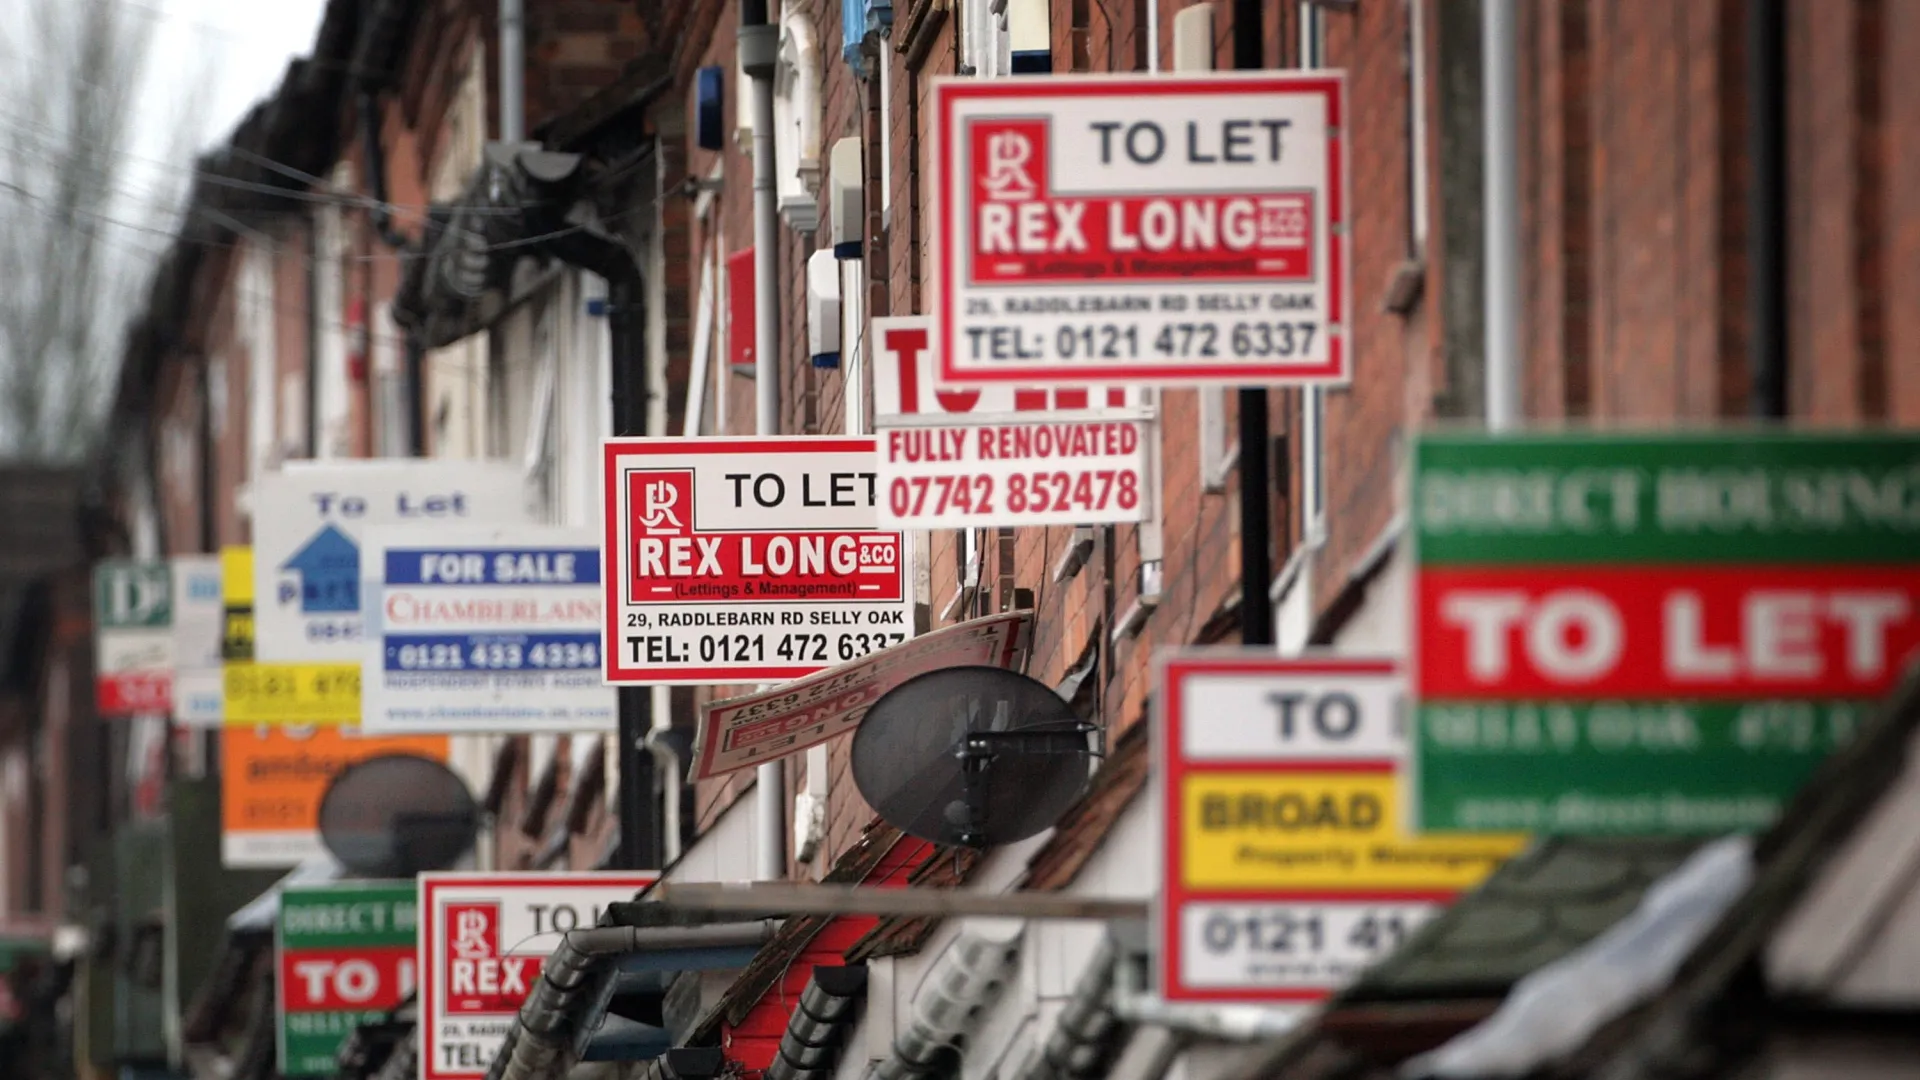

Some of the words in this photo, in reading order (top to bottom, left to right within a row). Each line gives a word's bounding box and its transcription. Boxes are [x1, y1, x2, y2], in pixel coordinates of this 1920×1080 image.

[1090, 121, 1166, 164] TO
[1187, 119, 1291, 163] LET
[978, 202, 1088, 253] REX
[1108, 198, 1256, 251] LONG
[1004, 294, 1152, 314] RADDLEBARN
[1160, 294, 1189, 312] RD
[1197, 293, 1261, 312] SELLY
[1269, 292, 1315, 311] OAK
[965, 326, 1044, 359] TEL:
[1056, 325, 1140, 359] 0121
[1154, 324, 1218, 357] 472
[1231, 322, 1317, 357] 6337
[889, 428, 966, 463] FULLY
[978, 422, 1138, 460] RENOVATED
[312, 492, 367, 517] To
[396, 491, 470, 517] Let
[725, 473, 785, 507] TO
[802, 472, 877, 507] LET
[889, 473, 994, 518] 07742
[1007, 469, 1138, 513] 852478
[420, 553, 485, 582] FOR
[493, 553, 576, 582] SALE
[638, 536, 723, 577] REX
[741, 535, 858, 576] LONG
[859, 545, 895, 564] &CO
[675, 582, 738, 598] (Lettings
[744, 582, 754, 594] &
[759, 581, 857, 597] Management)
[627, 613, 652, 629] 29,
[658, 612, 774, 627] RADDLEBARN
[782, 612, 804, 625] RD
[810, 611, 861, 625] SELLY
[868, 611, 904, 624] OAK
[1437, 586, 1624, 684] TO
[1660, 585, 1910, 683] LET
[398, 644, 464, 669] 0121
[470, 643, 522, 667] 433
[528, 643, 597, 667] 4334
[627, 635, 689, 662] TEL:
[700, 634, 764, 662] 0121
[777, 633, 828, 661] 472
[809, 672, 860, 697] 472
[731, 693, 799, 721] 6337
[1267, 691, 1361, 740] TO
[1200, 794, 1381, 831] BROAD
[285, 902, 385, 934] DIRECT
[526, 905, 577, 935] TO
[1204, 915, 1325, 953] 0121
[294, 959, 379, 1003] TO
[452, 960, 525, 994] REX
